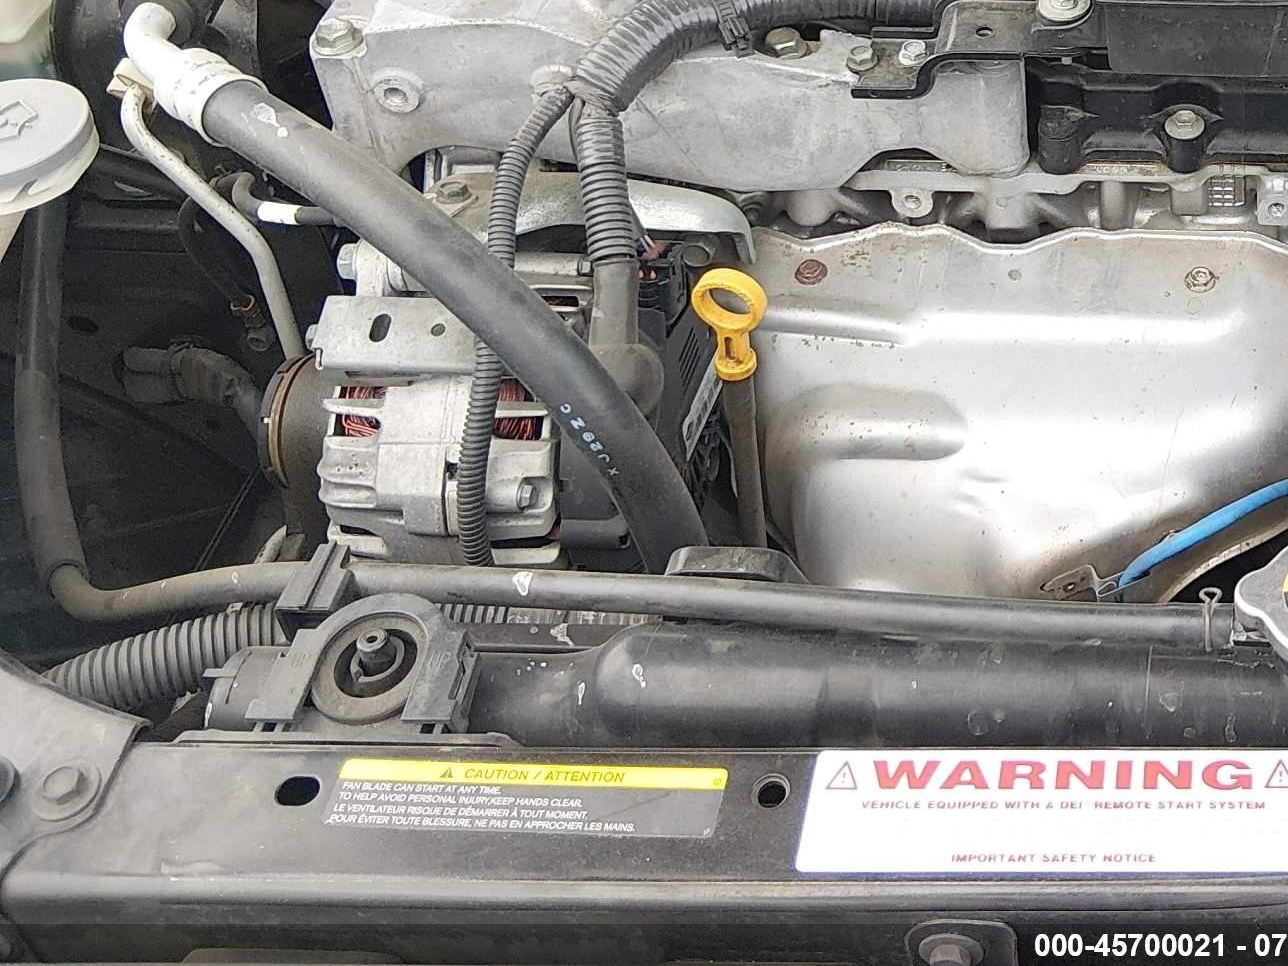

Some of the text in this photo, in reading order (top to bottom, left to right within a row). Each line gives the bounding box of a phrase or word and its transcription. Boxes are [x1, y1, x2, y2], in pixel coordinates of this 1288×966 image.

[464, 768, 529, 780] CAUTION
[544, 771, 625, 783] ATTENTION
[873, 760, 1254, 790] WARNING
[342, 781, 361, 790] FAN
[362, 781, 392, 791] BLADE
[393, 783, 413, 792] CAN
[414, 783, 445, 793] START
[445, 784, 457, 793] AT
[457, 785, 479, 794] ANY
[339, 791, 351, 800] TO
[352, 792, 378, 801] HELP
[378, 793, 406, 803] AVOID
[407, 794, 457, 804] PERSONAL
[516, 797, 549, 807] HANDS
[551, 798, 583, 807] CLEAR.
[862, 800, 921, 809] VEHICLE
[927, 800, 999, 809] EQUIPPED
[1004, 800, 1040, 809] WITH
[1045, 800, 1054, 810] A
[1094, 801, 1151, 810] REMOTE
[1158, 801, 1203, 810] START
[1209, 801, 1266, 810] SYSTEM
[333, 803, 345, 812] LE
[346, 804, 407, 815] VENTILATEUR
[407, 805, 444, 816] RISQUE
[444, 807, 457, 816] DE
[457, 805, 509, 818] DÉMARRER
[510, 806, 519, 817] À
[520, 809, 544, 818] TOUT
[330, 814, 356, 823] POUR
[358, 813, 390, 824] ÉVITER
[391, 816, 422, 825] TOUTE
[474, 819, 487, 828] NE
[489, 819, 508, 828] PAS
[509, 820, 522, 829] EN
[522, 820, 583, 831] APPROCHER
[583, 822, 603, 832] LES
[603, 823, 636, 832] MAINS.
[951, 853, 1156, 863] IMPORTANT SAFETY NOTICE
